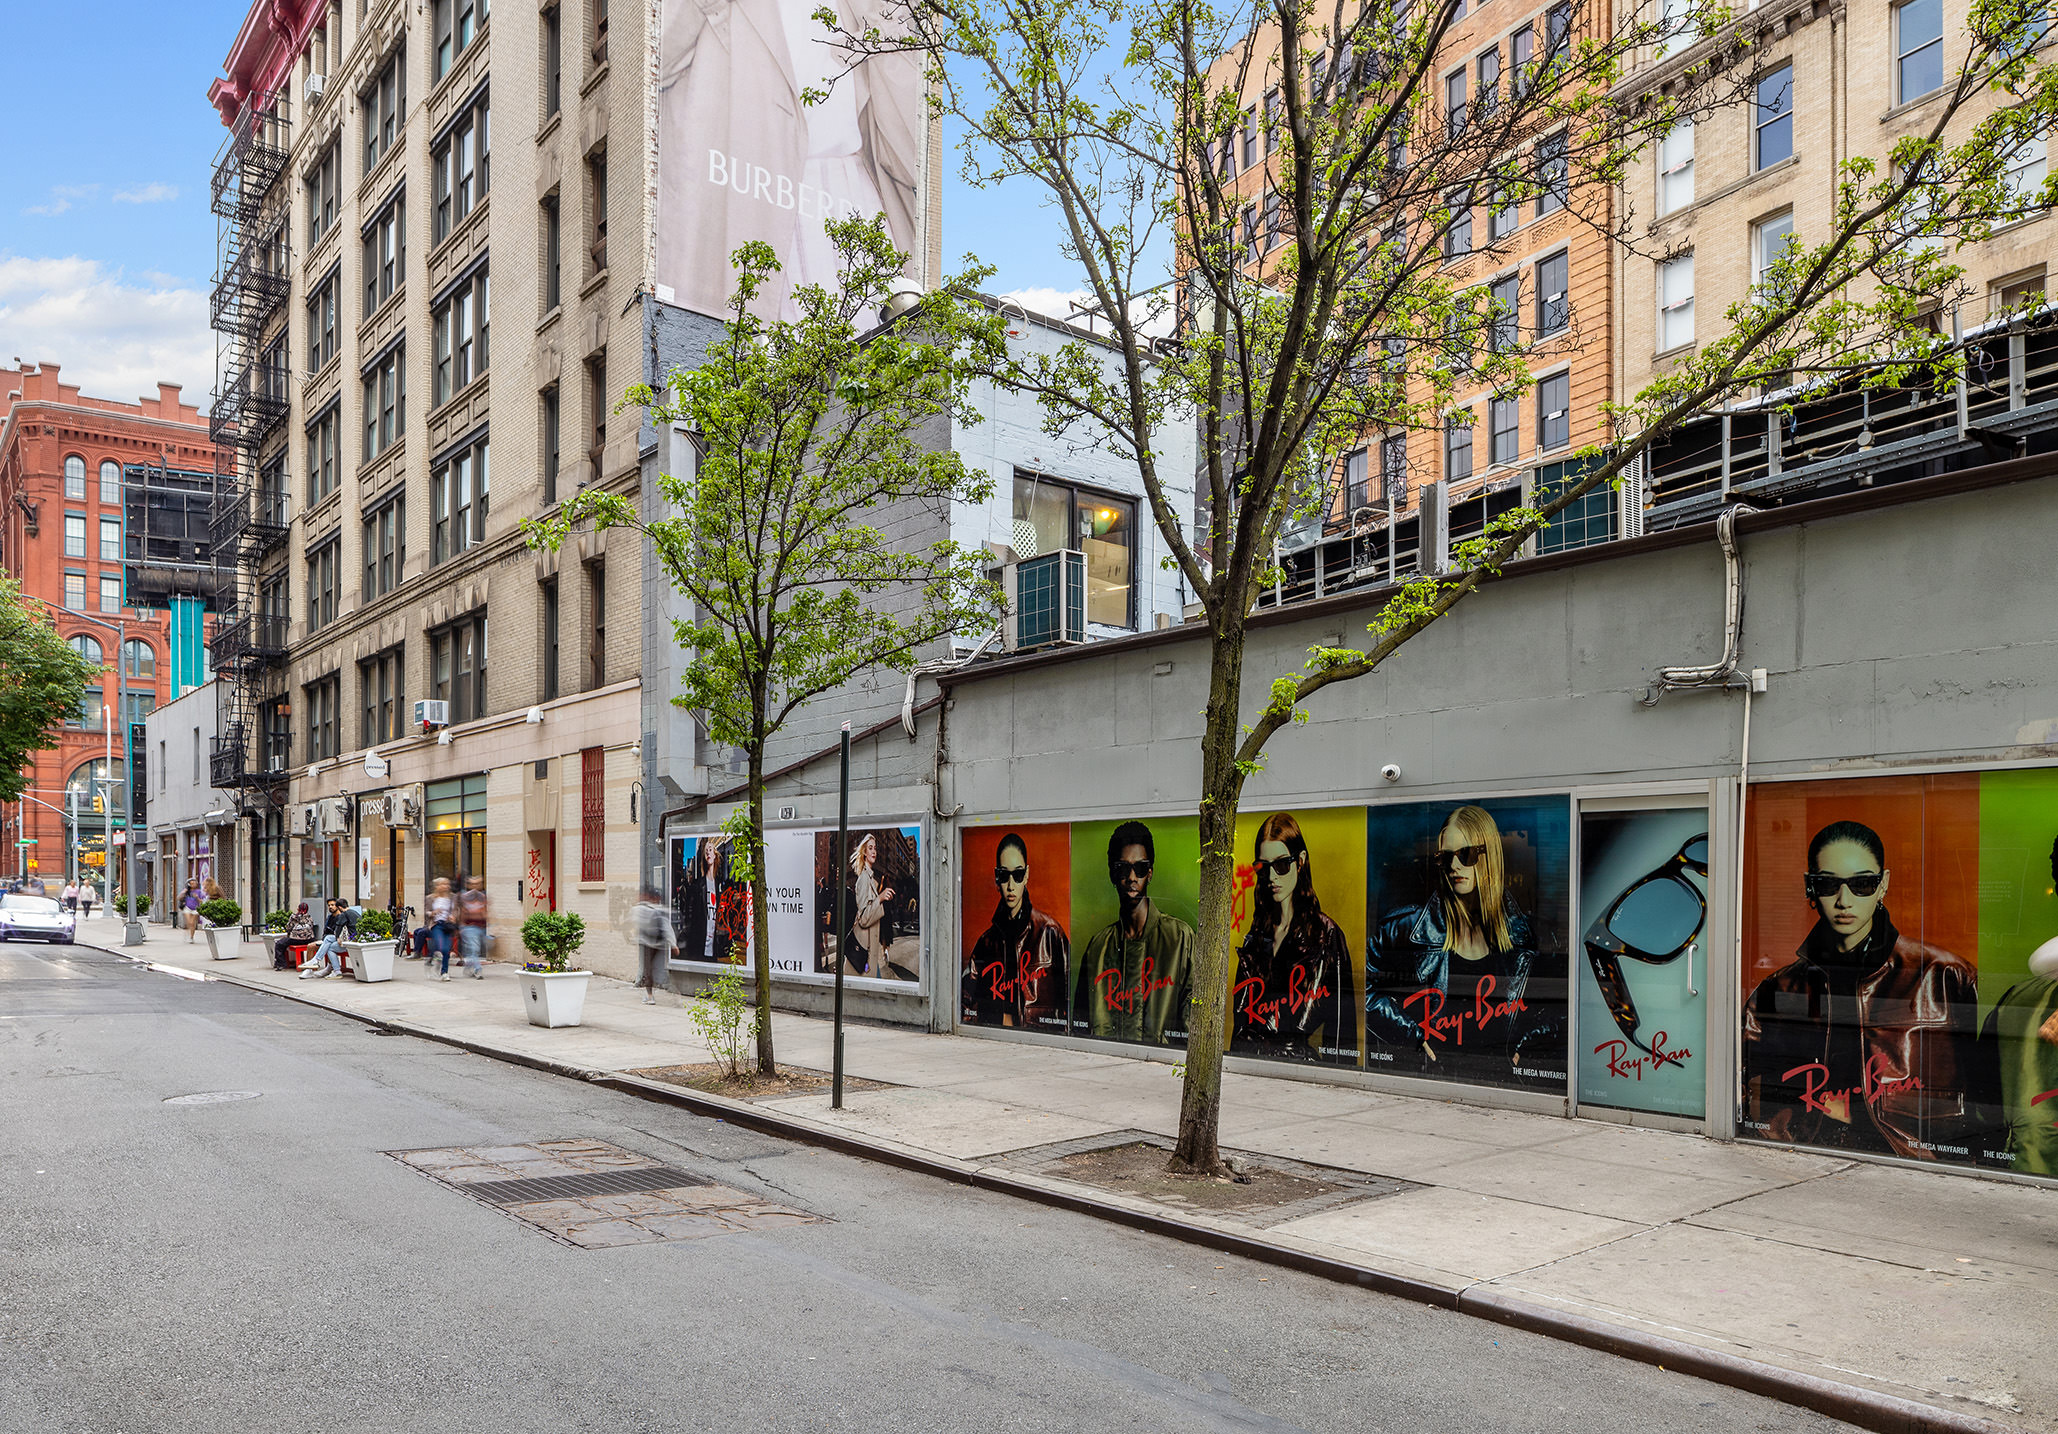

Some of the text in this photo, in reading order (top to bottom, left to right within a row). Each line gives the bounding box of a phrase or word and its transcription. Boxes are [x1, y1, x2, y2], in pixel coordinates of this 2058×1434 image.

[775, 887, 801, 898] YOUR
[781, 902, 804, 914] TIME
[769, 958, 802, 972] OACH
[1318, 1046, 1327, 1054] THE
[1370, 1052, 1394, 1062] THE ICONS
[1513, 1067, 1567, 1080] THE MEGA WAYFARER
[1744, 1120, 1771, 1131] THE ICONS
[1908, 1140, 1969, 1155] THE MEGA WAYFARER
[1984, 1150, 2016, 1161] THE ICONS
